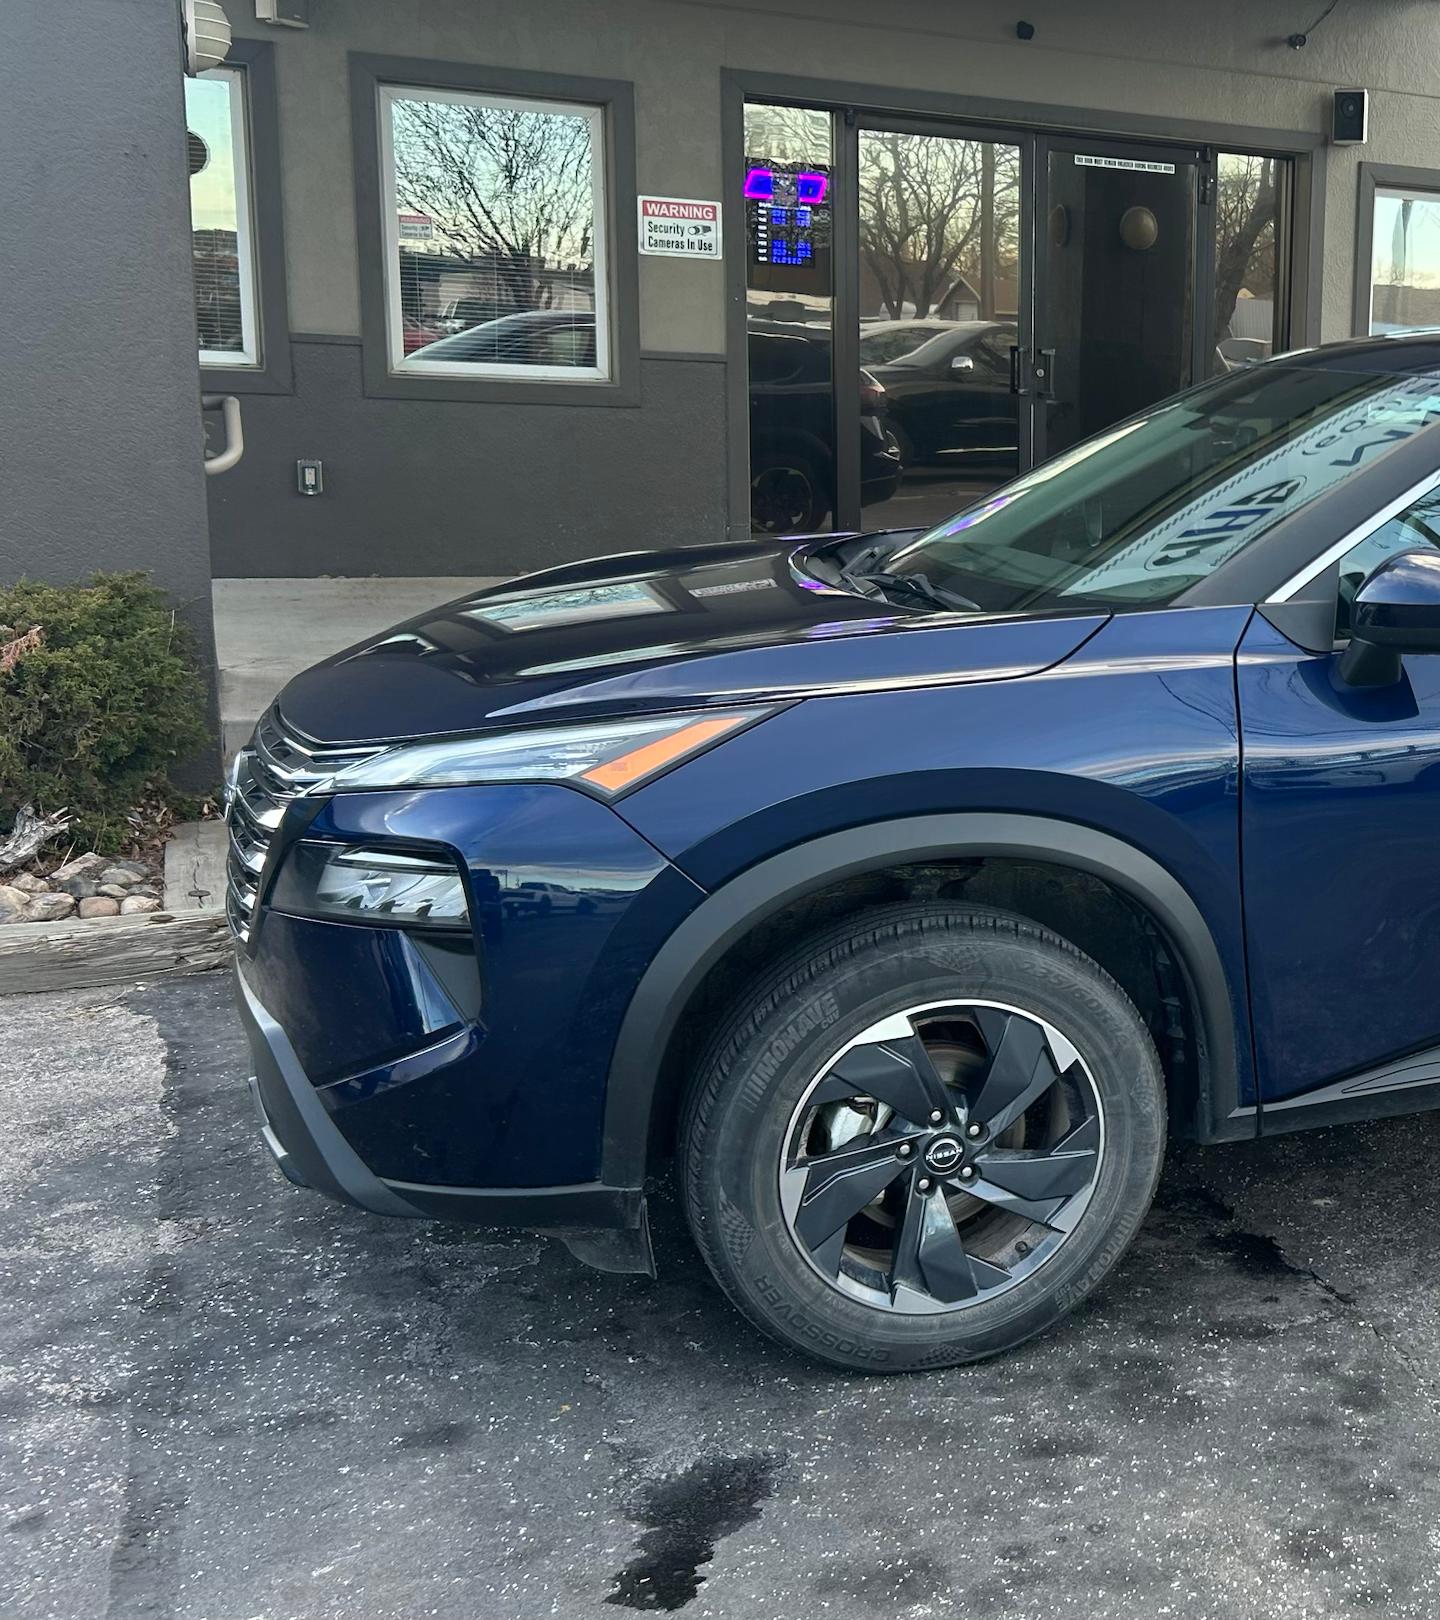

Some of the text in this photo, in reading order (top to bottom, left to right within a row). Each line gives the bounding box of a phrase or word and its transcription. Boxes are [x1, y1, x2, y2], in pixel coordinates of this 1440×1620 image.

[647, 203, 713, 219] WARNING
[648, 221, 685, 237] Security
[648, 236, 713, 251] Cameras In Use
[926, 1146, 963, 1161] NISSAN
[753, 1274, 890, 1363] CROSSOVER
